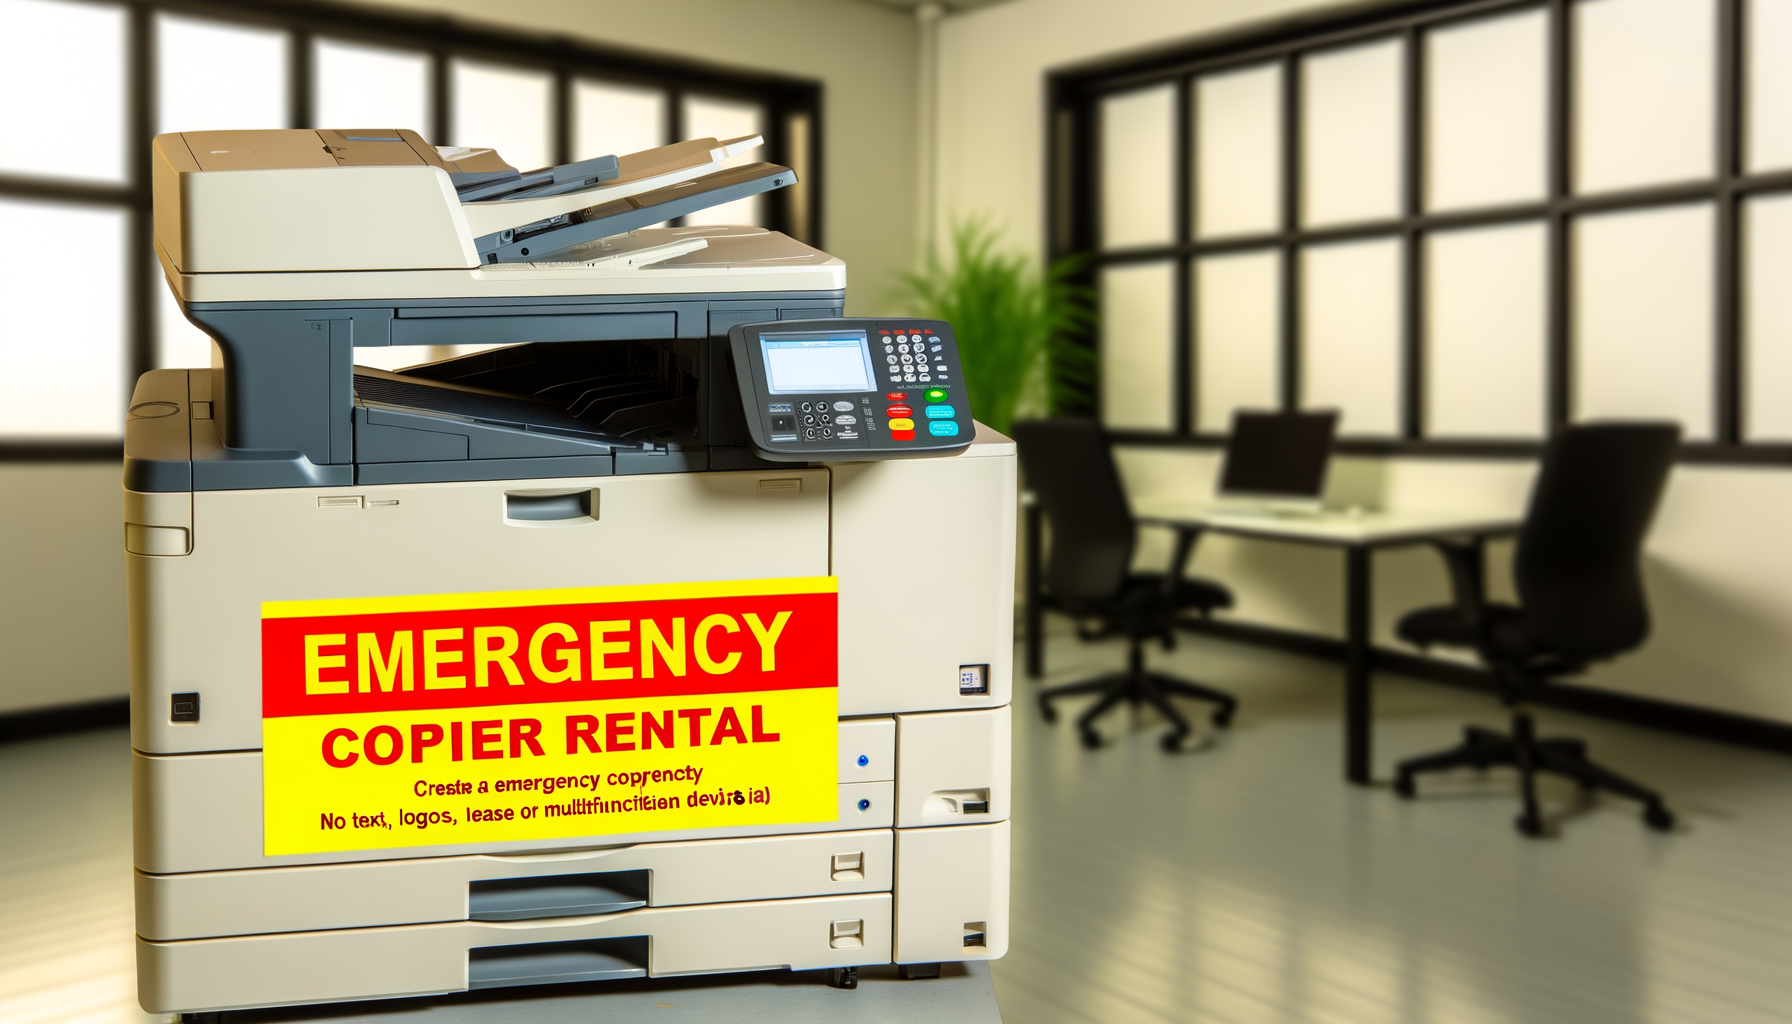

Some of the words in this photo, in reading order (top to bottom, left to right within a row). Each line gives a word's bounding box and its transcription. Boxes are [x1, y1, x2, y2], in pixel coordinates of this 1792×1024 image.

[304, 610, 793, 696] EMERGENCY
[321, 717, 546, 769] COPIER
[565, 704, 781, 755] RENTAL
[477, 780, 489, 794] a
[494, 774, 601, 795] emergency
[320, 812, 347, 830] No
[399, 808, 457, 830] logos,
[466, 806, 515, 823] lease
[520, 805, 539, 820] or
